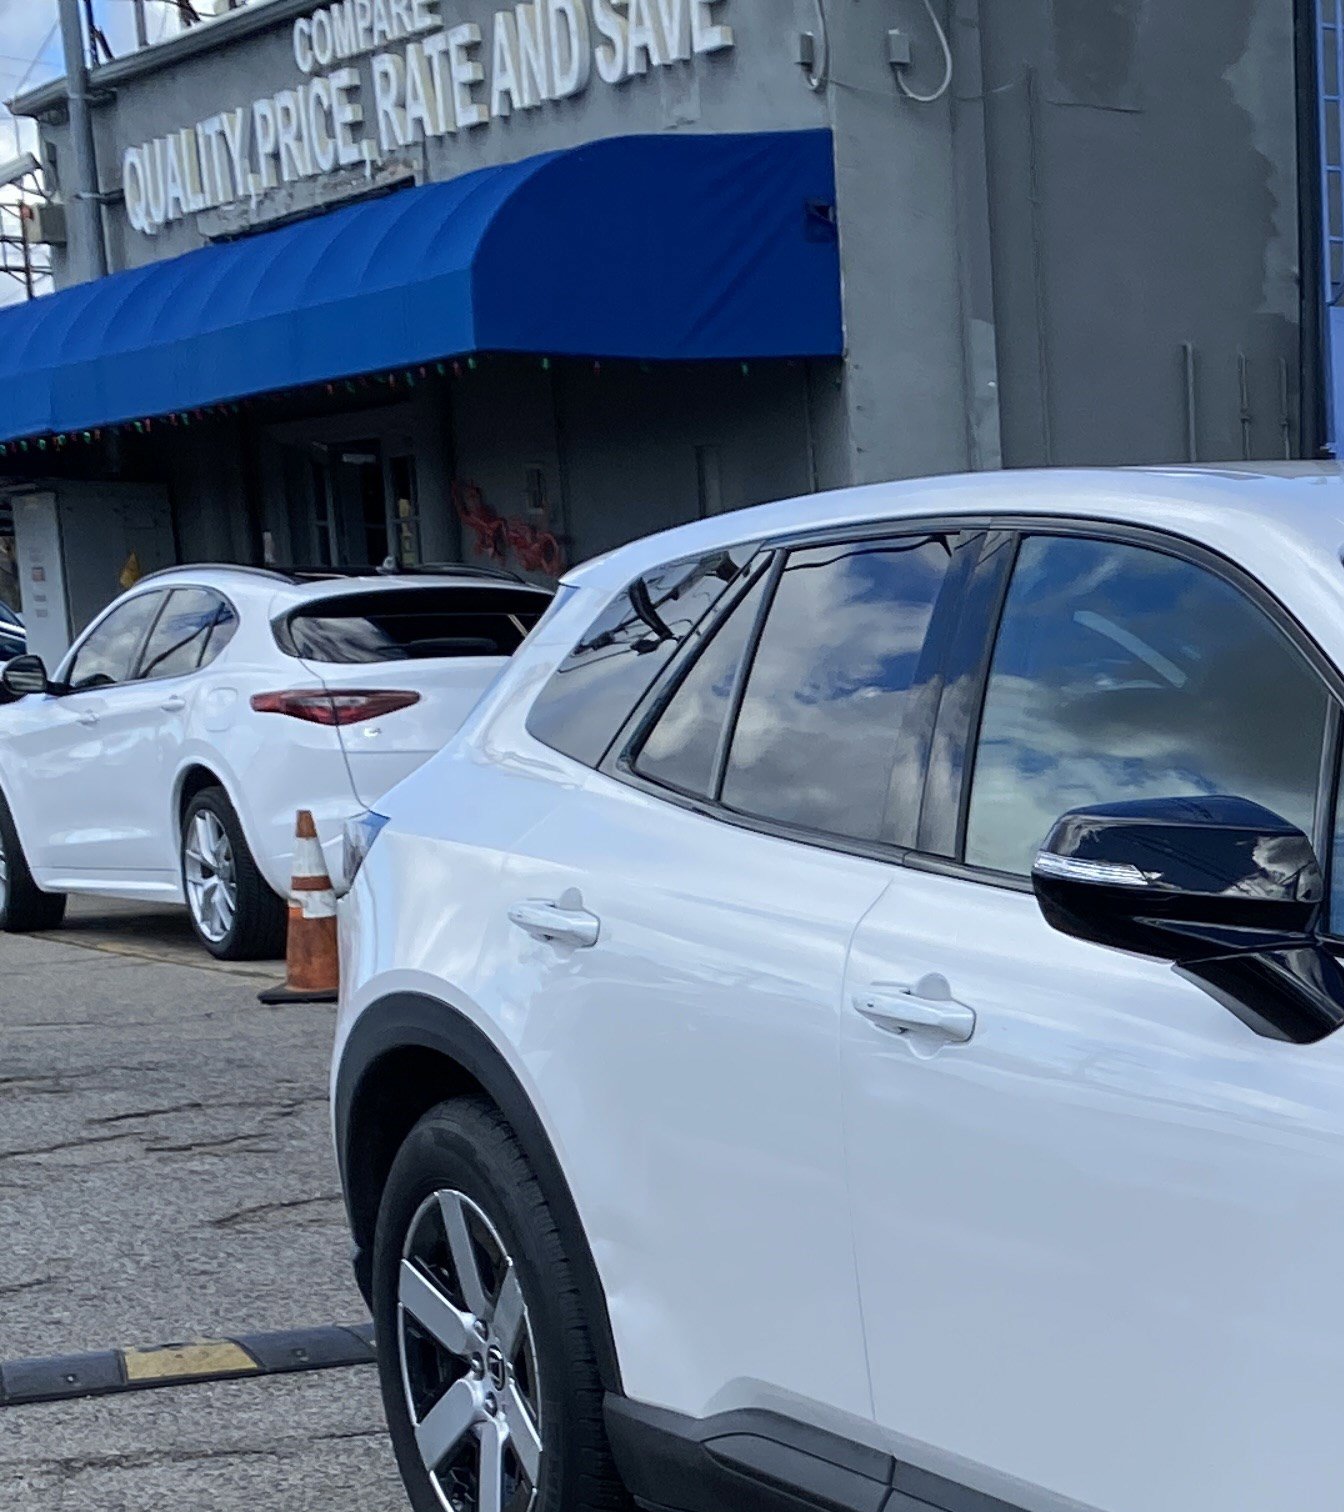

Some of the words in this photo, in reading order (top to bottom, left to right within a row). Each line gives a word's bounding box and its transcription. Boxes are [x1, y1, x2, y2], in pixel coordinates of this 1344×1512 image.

[293, 0, 443, 72] COMPARE
[371, 23, 489, 150] RATE
[491, 0, 590, 117] AND
[593, 0, 734, 84] SAVE
